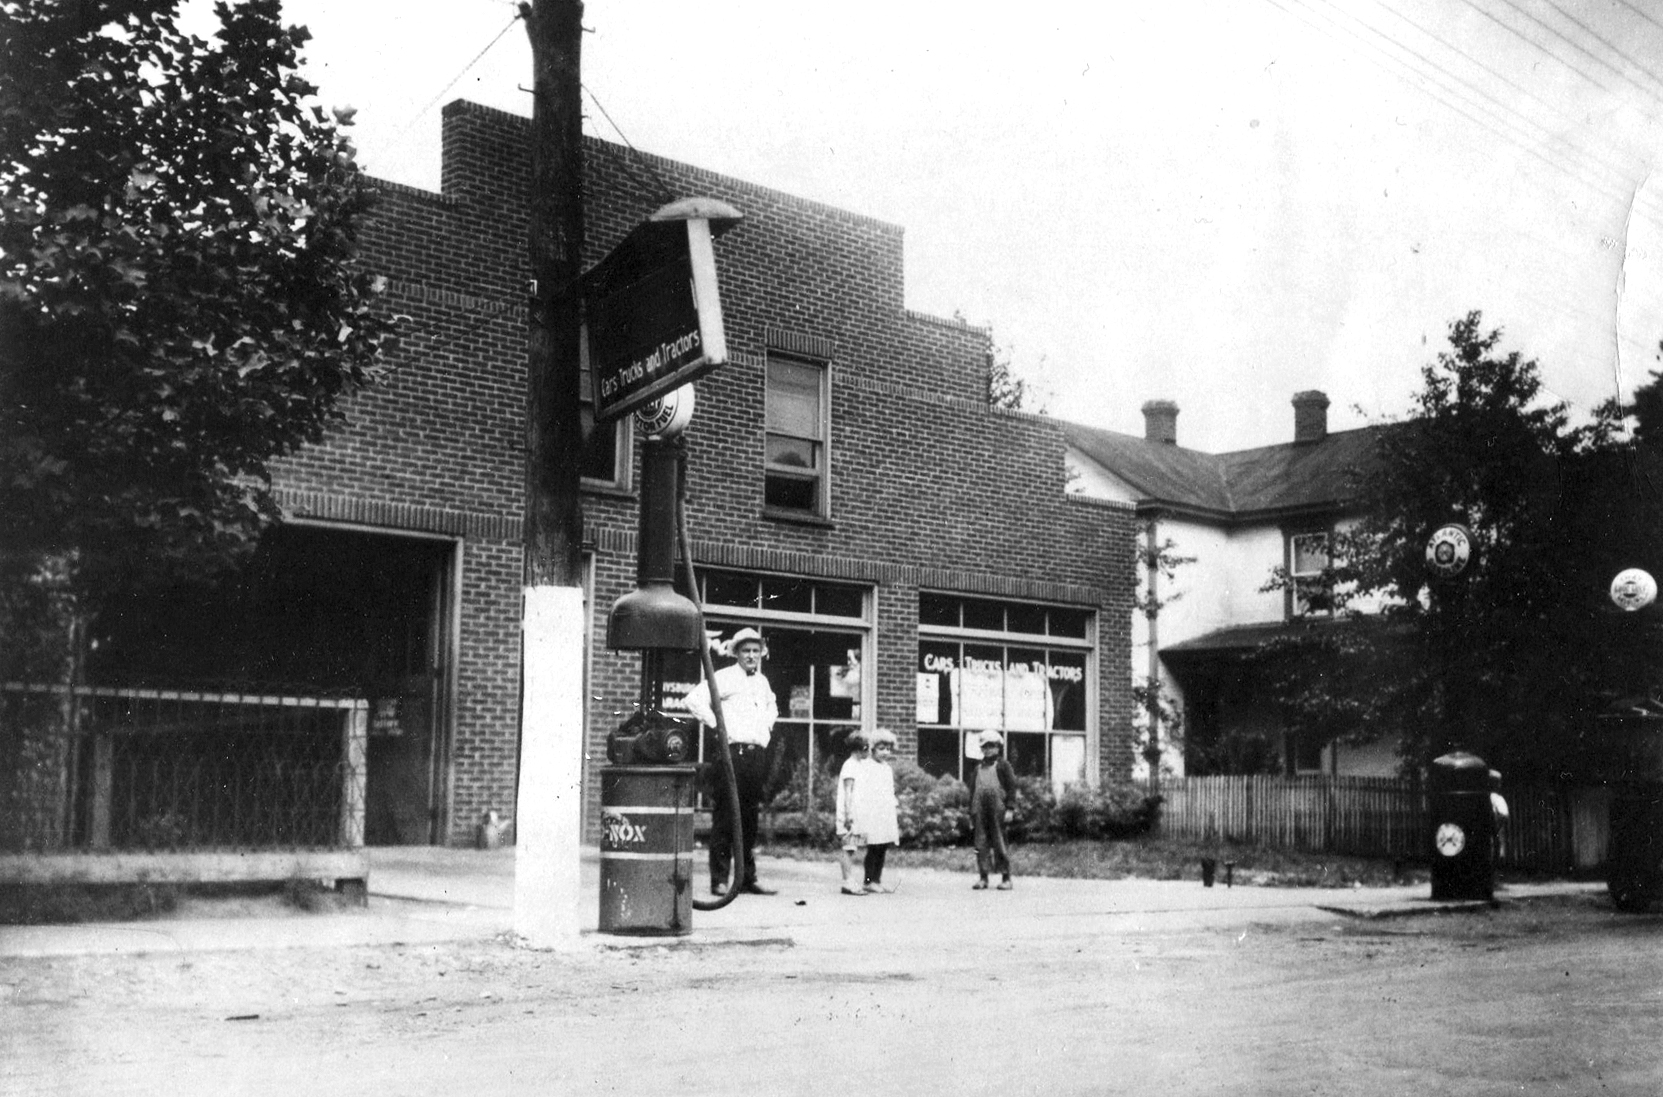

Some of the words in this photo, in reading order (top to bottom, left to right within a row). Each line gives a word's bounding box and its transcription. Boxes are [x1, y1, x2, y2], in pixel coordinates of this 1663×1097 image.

[601, 376, 618, 398] Cars
[618, 361, 644, 388] Trucks
[645, 347, 662, 373] and
[661, 330, 700, 364] Tractors
[634, 413, 656, 431] OTOR
[655, 404, 674, 428] FUEL
[1428, 529, 1467, 549] ATLANTIC
